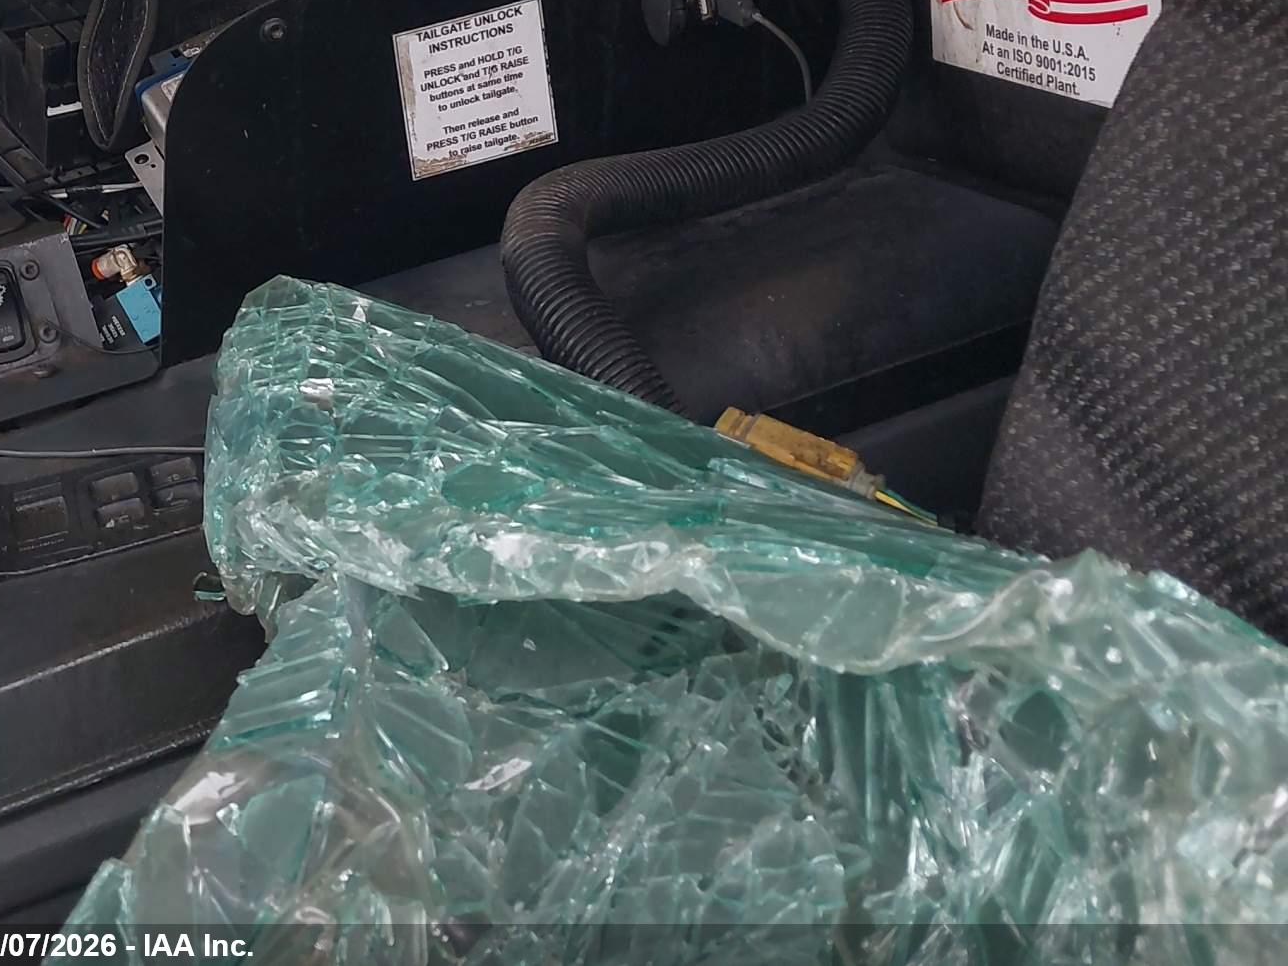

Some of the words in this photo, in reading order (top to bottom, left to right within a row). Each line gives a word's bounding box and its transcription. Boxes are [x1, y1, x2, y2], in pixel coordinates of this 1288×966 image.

[416, 21, 471, 43] TAILGATE
[474, 6, 523, 26] UNLOCK
[429, 24, 514, 54] INSTRUCTIONS
[986, 24, 1014, 43] Made
[1018, 31, 1027, 45] in
[1031, 34, 1049, 51] the
[1053, 40, 1090, 61] U.S.A.
[421, 75, 461, 92] UNLOCK
[463, 71, 480, 81] and
[482, 65, 498, 77] T/G
[500, 56, 529, 70] RAISE
[424, 65, 456, 79] PRESS
[458, 58, 475, 70] and
[477, 50, 504, 65] HOLD
[506, 46, 522, 57] T/G
[982, 42, 995, 55] At
[997, 47, 1010, 60] an
[1013, 49, 1032, 64] ISO
[1036, 54, 1096, 81] 9001:2015
[430, 87, 464, 102] buttons
[467, 84, 475, 92] at
[477, 78, 501, 90] same
[504, 71, 523, 83] time
[997, 63, 1043, 86] Certified
[1047, 74, 1080, 95] Plant.
[438, 104, 447, 112] to
[450, 94, 480, 109] unlock
[482, 86, 518, 102] tailgate.
[427, 137, 458, 151] PRESS
[460, 132, 477, 142] T/G
[479, 123, 507, 137] RAISE
[510, 116, 538, 130] button
[443, 122, 466, 135] Then
[468, 114, 500, 129] release
[503, 108, 519, 120] and
[449, 149, 458, 158] to
[461, 143, 482, 154] raise
[484, 134, 520, 149] tailgate.
